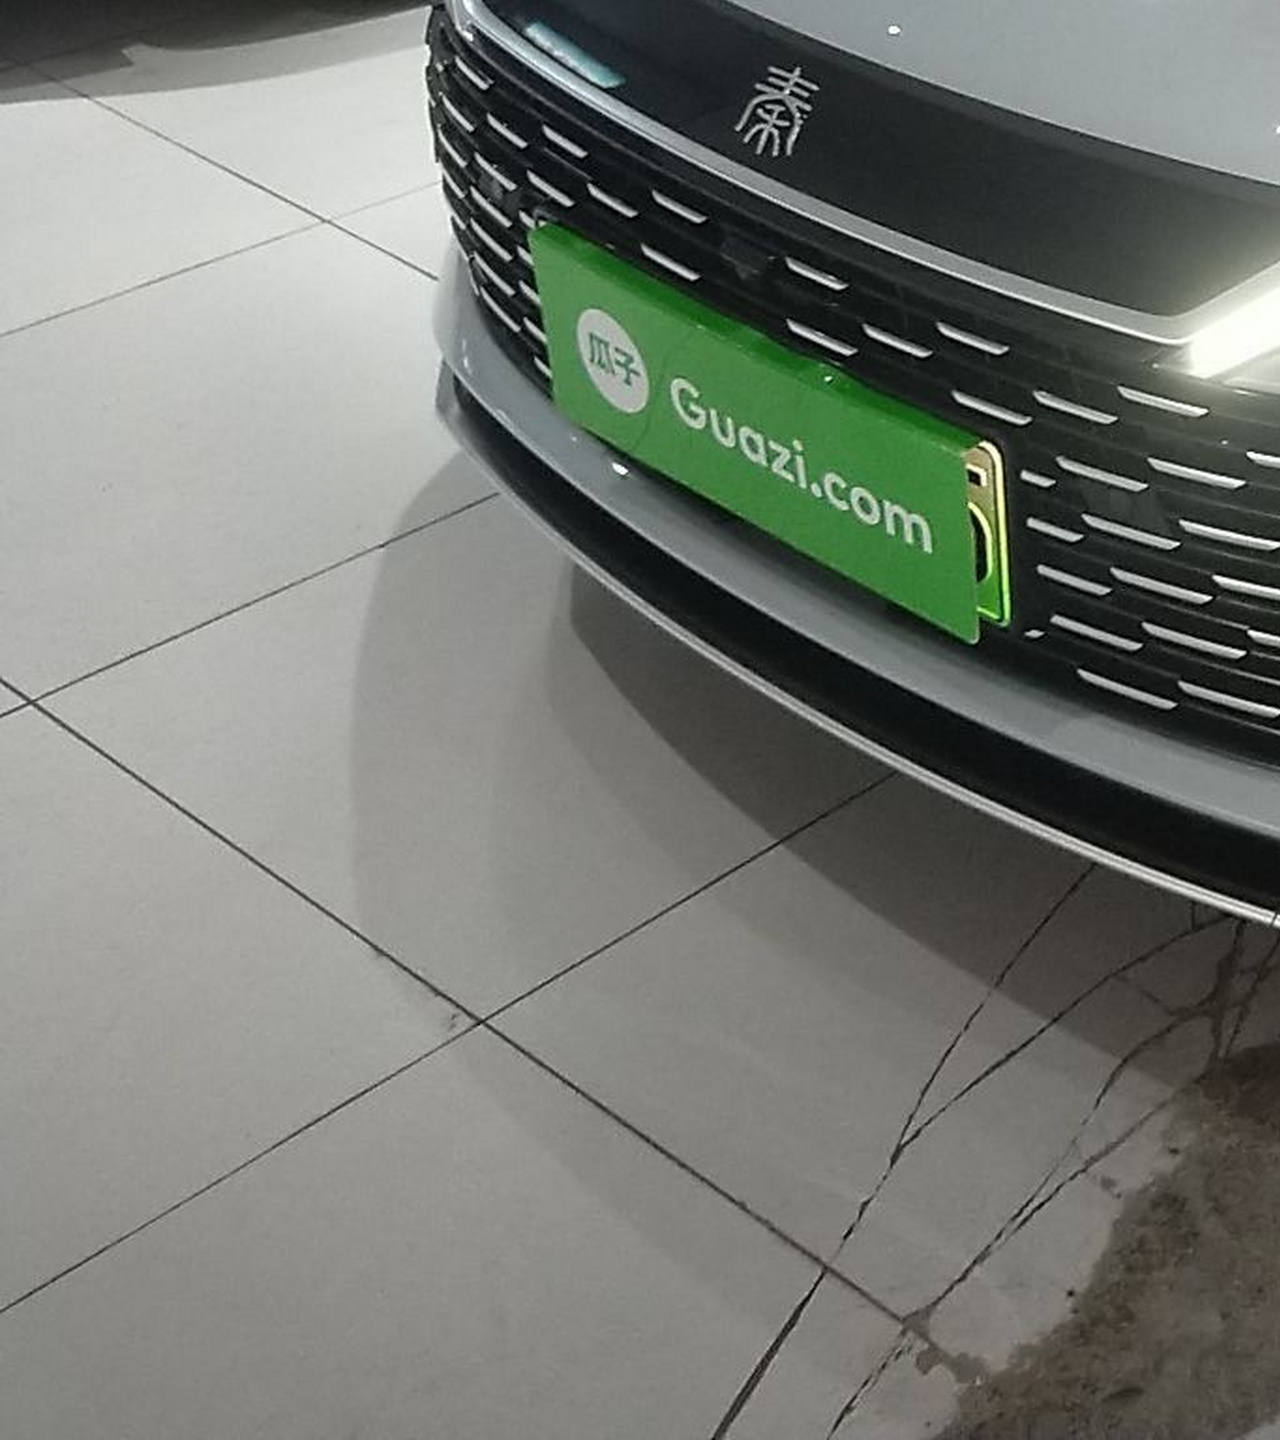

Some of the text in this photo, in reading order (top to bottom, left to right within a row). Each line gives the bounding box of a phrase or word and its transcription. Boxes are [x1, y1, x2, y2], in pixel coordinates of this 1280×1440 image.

[735, 66, 820, 157] 秦
[588, 331, 641, 387] 瓜子
[669, 377, 933, 554] Guazi.com
